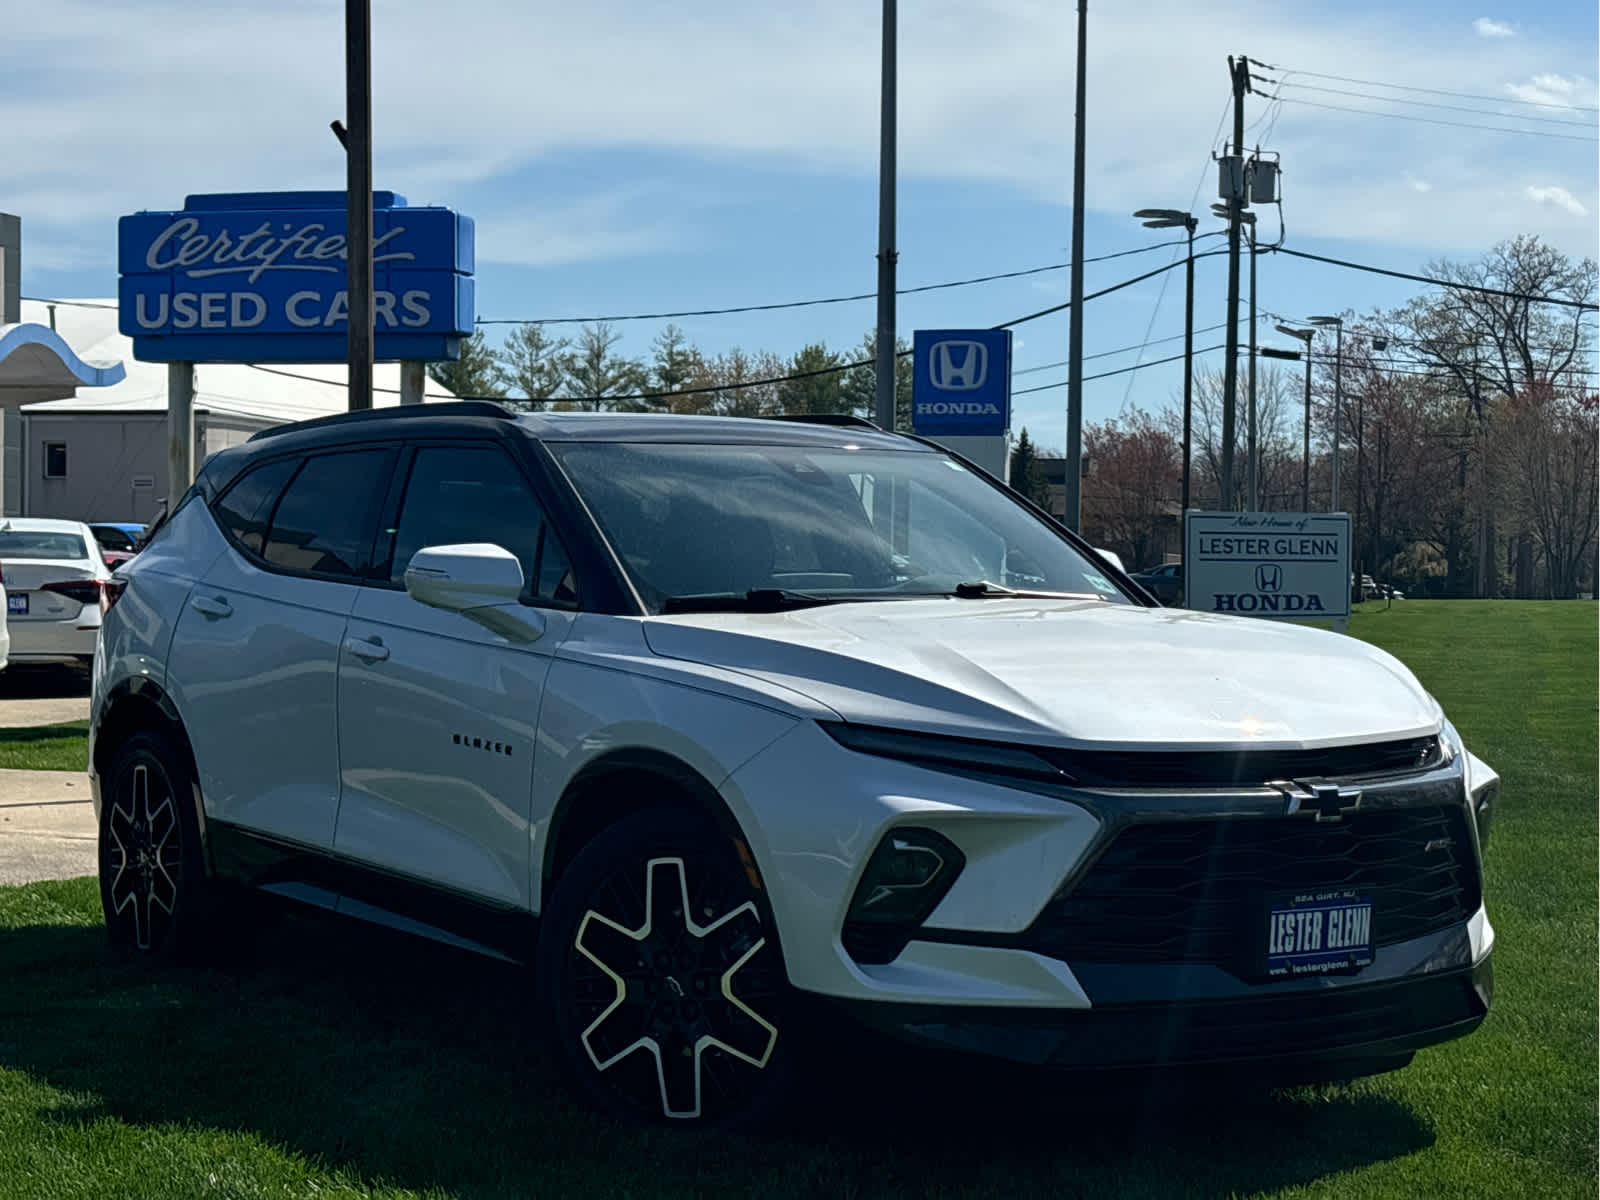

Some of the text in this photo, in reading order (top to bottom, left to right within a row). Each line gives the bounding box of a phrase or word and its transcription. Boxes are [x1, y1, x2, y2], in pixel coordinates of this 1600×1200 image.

[136, 291, 431, 329] USED CARS
[916, 402, 1000, 415] HONDA
[1200, 538, 1338, 555] LESTER GLENN
[1213, 593, 1325, 611] HONDA
[453, 734, 512, 756] BLAZER
[1269, 907, 1371, 954] LESTER GLENN
